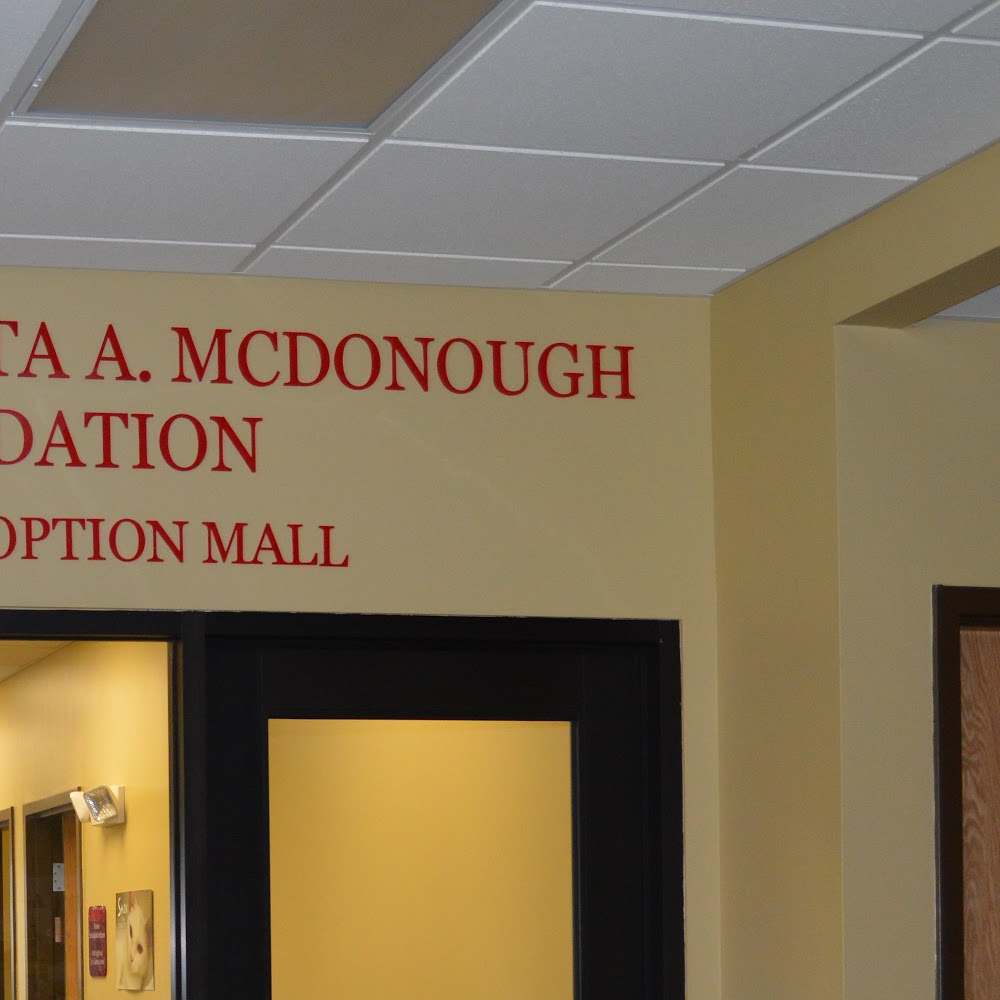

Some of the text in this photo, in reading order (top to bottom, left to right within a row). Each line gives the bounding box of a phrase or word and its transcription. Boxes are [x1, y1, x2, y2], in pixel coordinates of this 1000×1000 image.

[85, 323, 152, 383] A.
[171, 326, 636, 400] MCDONOUGH
[203, 521, 350, 568] MALL
